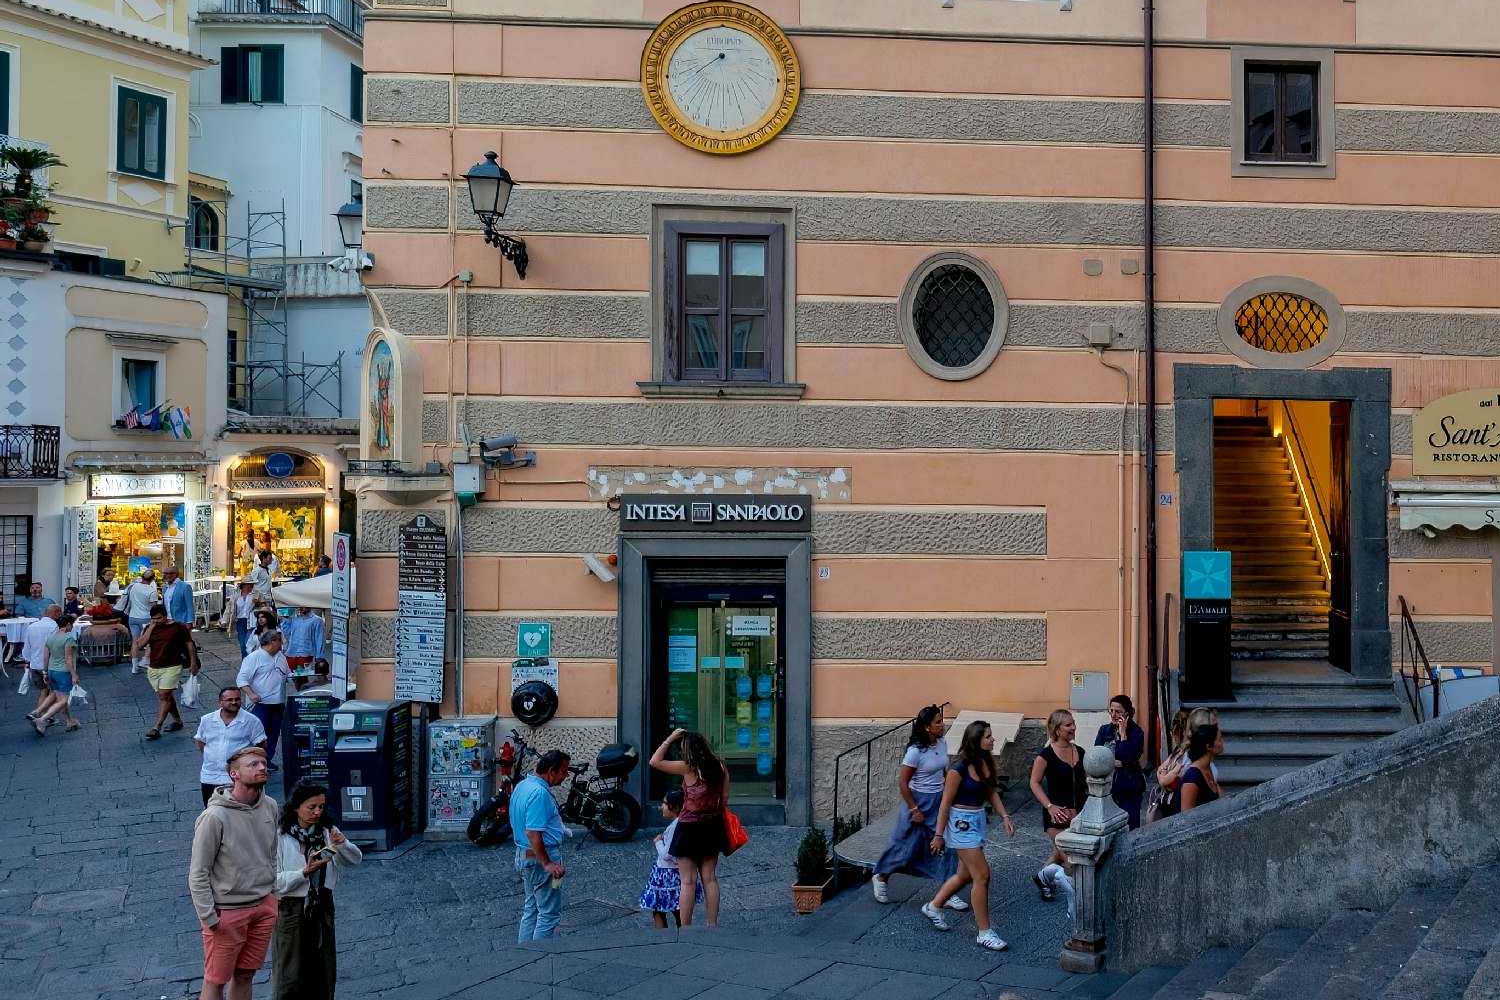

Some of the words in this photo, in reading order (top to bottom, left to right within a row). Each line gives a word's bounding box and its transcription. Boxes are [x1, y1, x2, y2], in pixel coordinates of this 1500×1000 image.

[1160, 494, 1172, 506] 24
[625, 503, 687, 521] INTESA
[716, 503, 805, 522] SANPAOLO
[1484, 509, 1500, 523] S.
